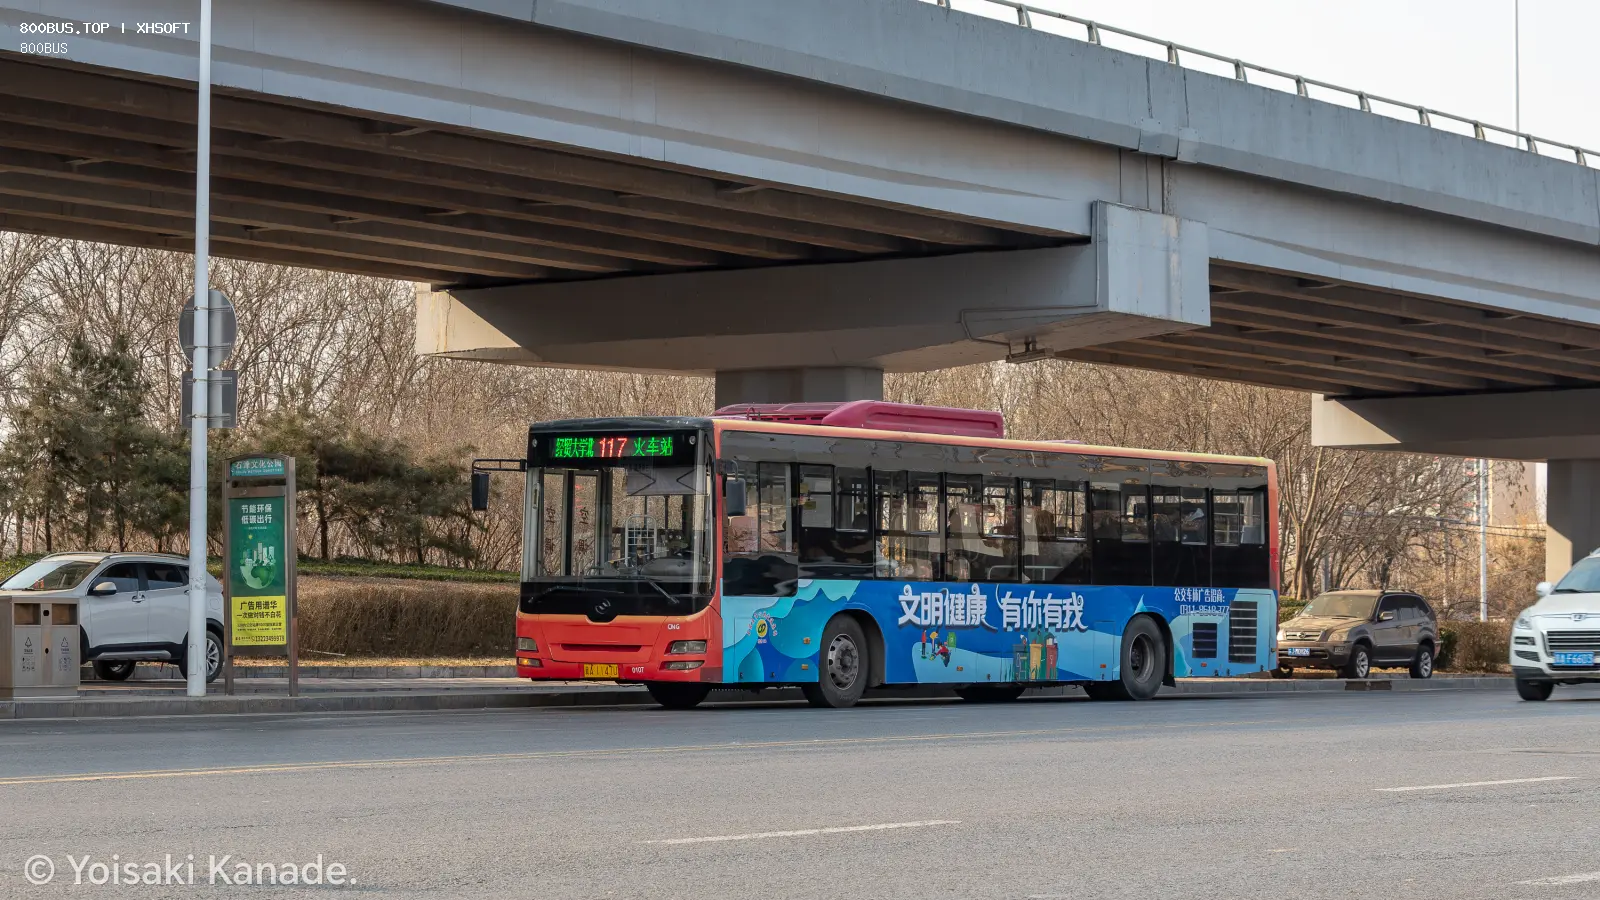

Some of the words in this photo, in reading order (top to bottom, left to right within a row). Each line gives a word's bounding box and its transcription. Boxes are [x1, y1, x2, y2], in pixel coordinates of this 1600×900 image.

[599, 437, 628, 458] 117
[633, 436, 674, 457] 火车站
[241, 503, 272, 514] 节能环保
[241, 515, 272, 525] 低碳出行
[898, 584, 998, 632] 文明健康
[996, 584, 1088, 632] 有你有我
[667, 623, 680, 631] CNG
